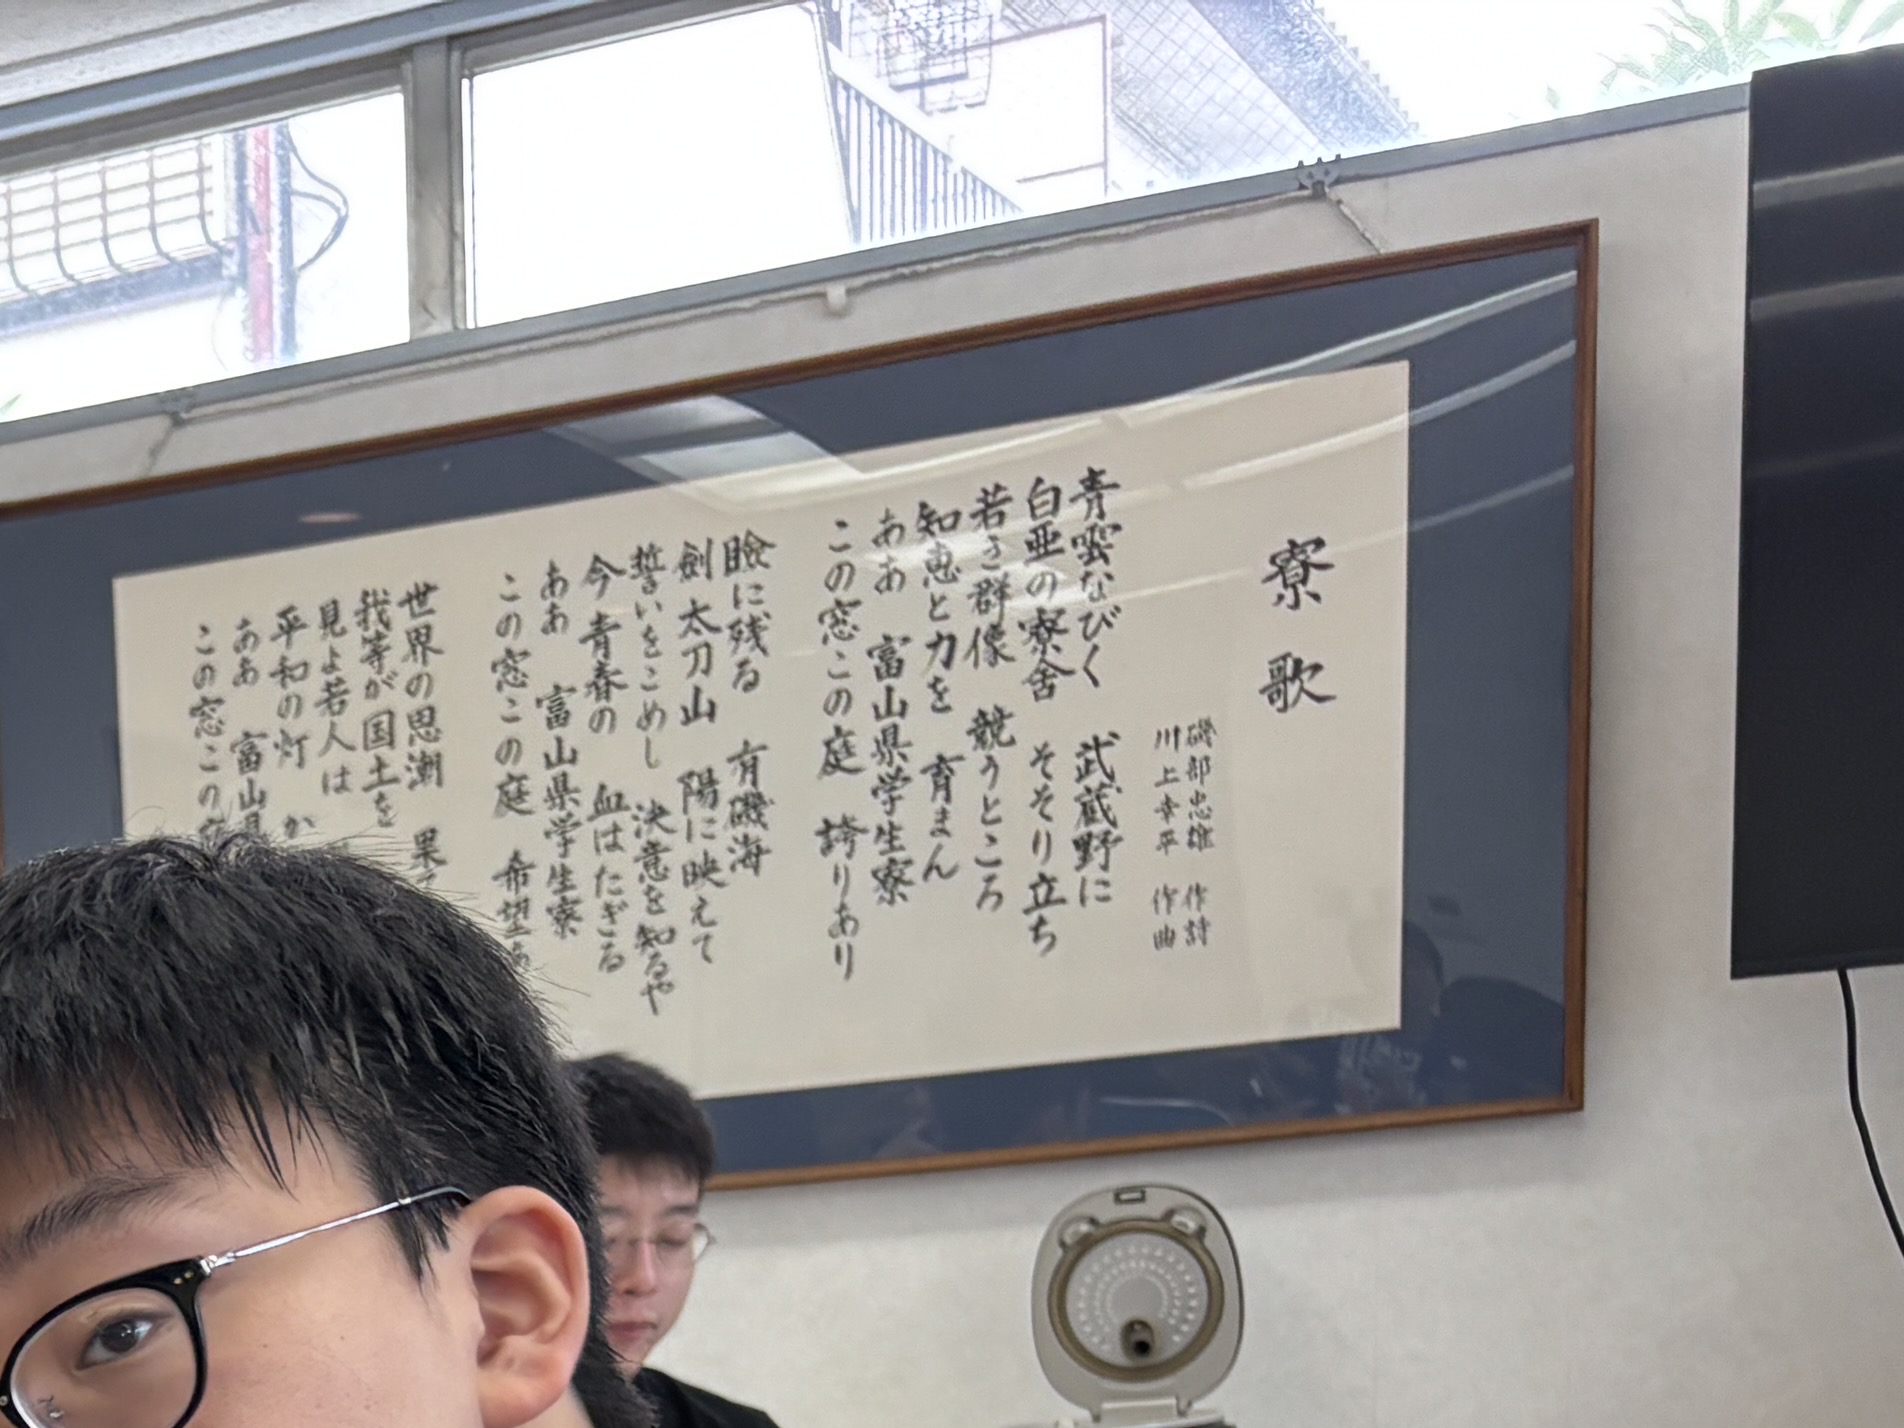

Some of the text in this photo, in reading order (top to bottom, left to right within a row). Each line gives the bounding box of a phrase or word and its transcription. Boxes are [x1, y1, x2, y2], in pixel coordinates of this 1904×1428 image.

[313, 597, 357, 797] 見よ若人は
[352, 587, 402, 828] 我等が国土を
[396, 580, 446, 792] 世界の思潮
[491, 572, 536, 818] この窓この庭
[817, 519, 866, 781] この窓この庭
[866, 507, 916, 908] ああ 富山県学生寮
[915, 500, 962, 714] 知恵と力を
[1258, 536, 1338, 714] 寮歌
[535, 558, 583, 941] ああ 富山県学生寮
[966, 704, 1018, 912] 競うところ
[1022, 740, 1067, 957] そそり立ち
[1071, 730, 1125, 908] 武蔵野に
[586, 781, 631, 975] 血はたぎる
[676, 766, 730, 965] 陽に映えて
